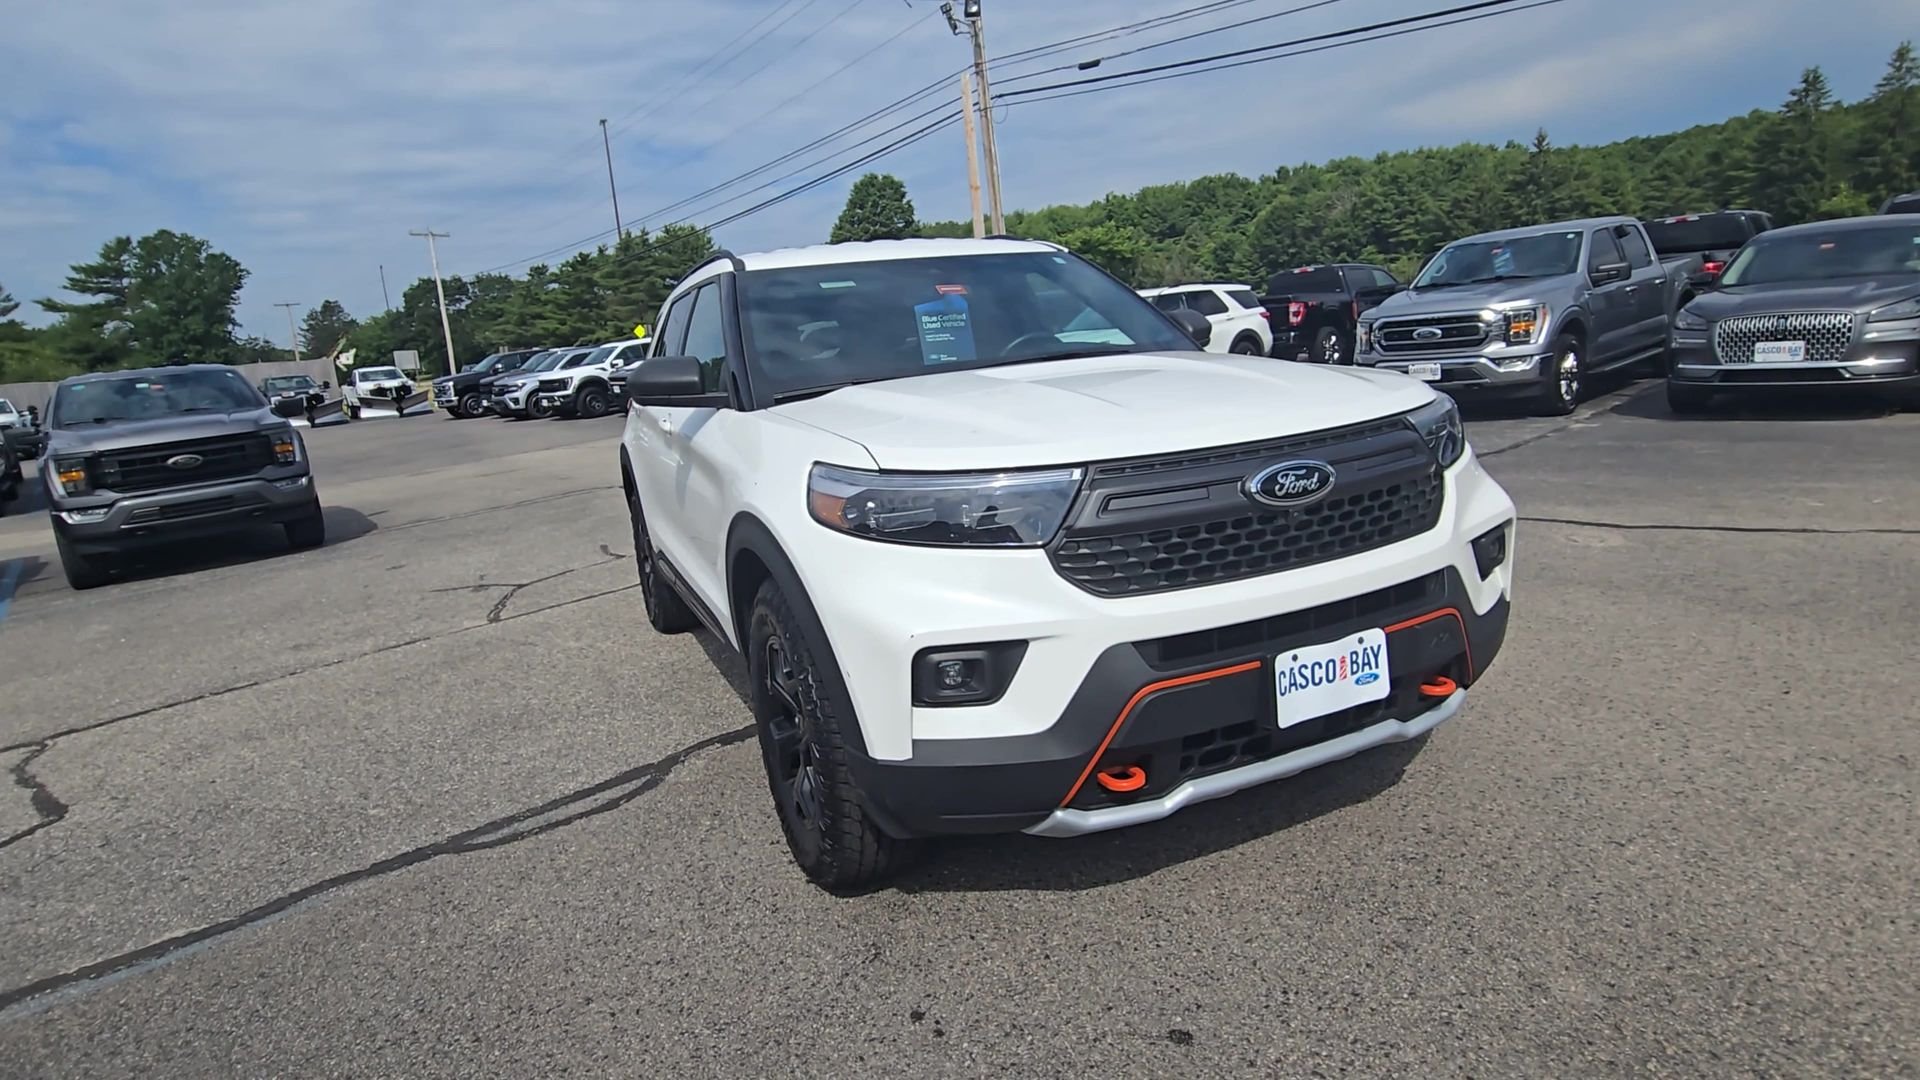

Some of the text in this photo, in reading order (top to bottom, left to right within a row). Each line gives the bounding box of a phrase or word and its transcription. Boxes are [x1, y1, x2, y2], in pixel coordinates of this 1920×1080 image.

[1275, 469, 1319, 496] Ford
[1278, 644, 1382, 697] CASCO BAY
